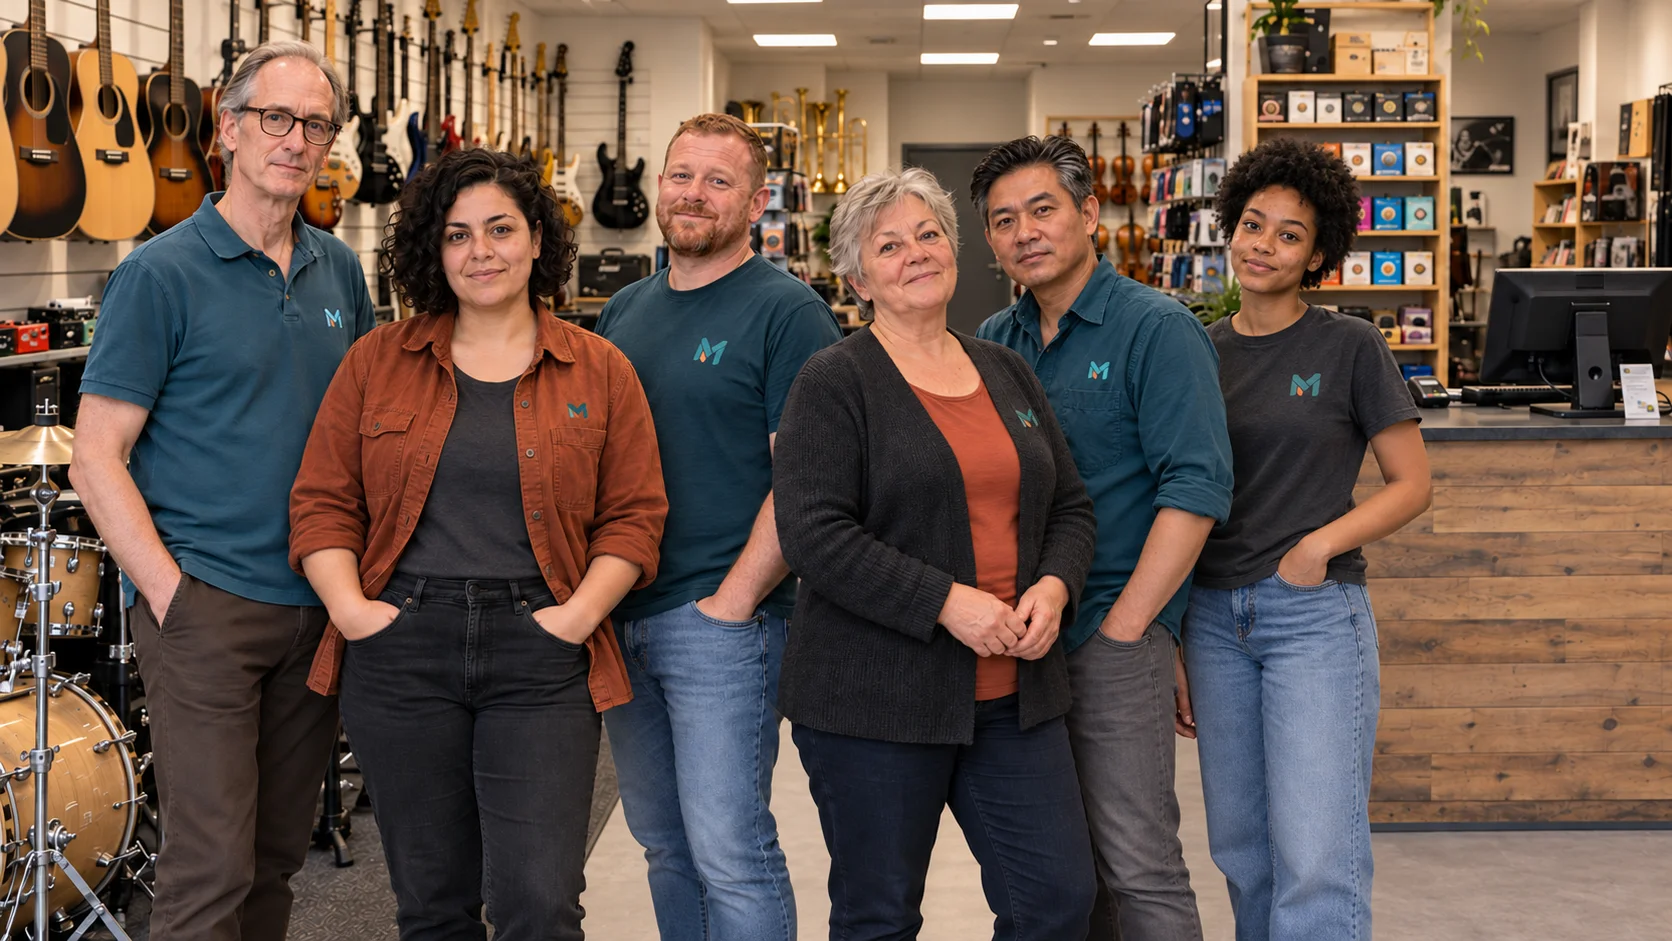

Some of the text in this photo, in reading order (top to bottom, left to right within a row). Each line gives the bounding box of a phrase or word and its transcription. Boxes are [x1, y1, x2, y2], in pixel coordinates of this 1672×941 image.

[324, 308, 343, 328] M
[693, 337, 728, 365] M
[1087, 361, 1110, 380] M
[1289, 373, 1321, 396] M
[567, 402, 588, 418] M
[1015, 408, 1038, 427] M
